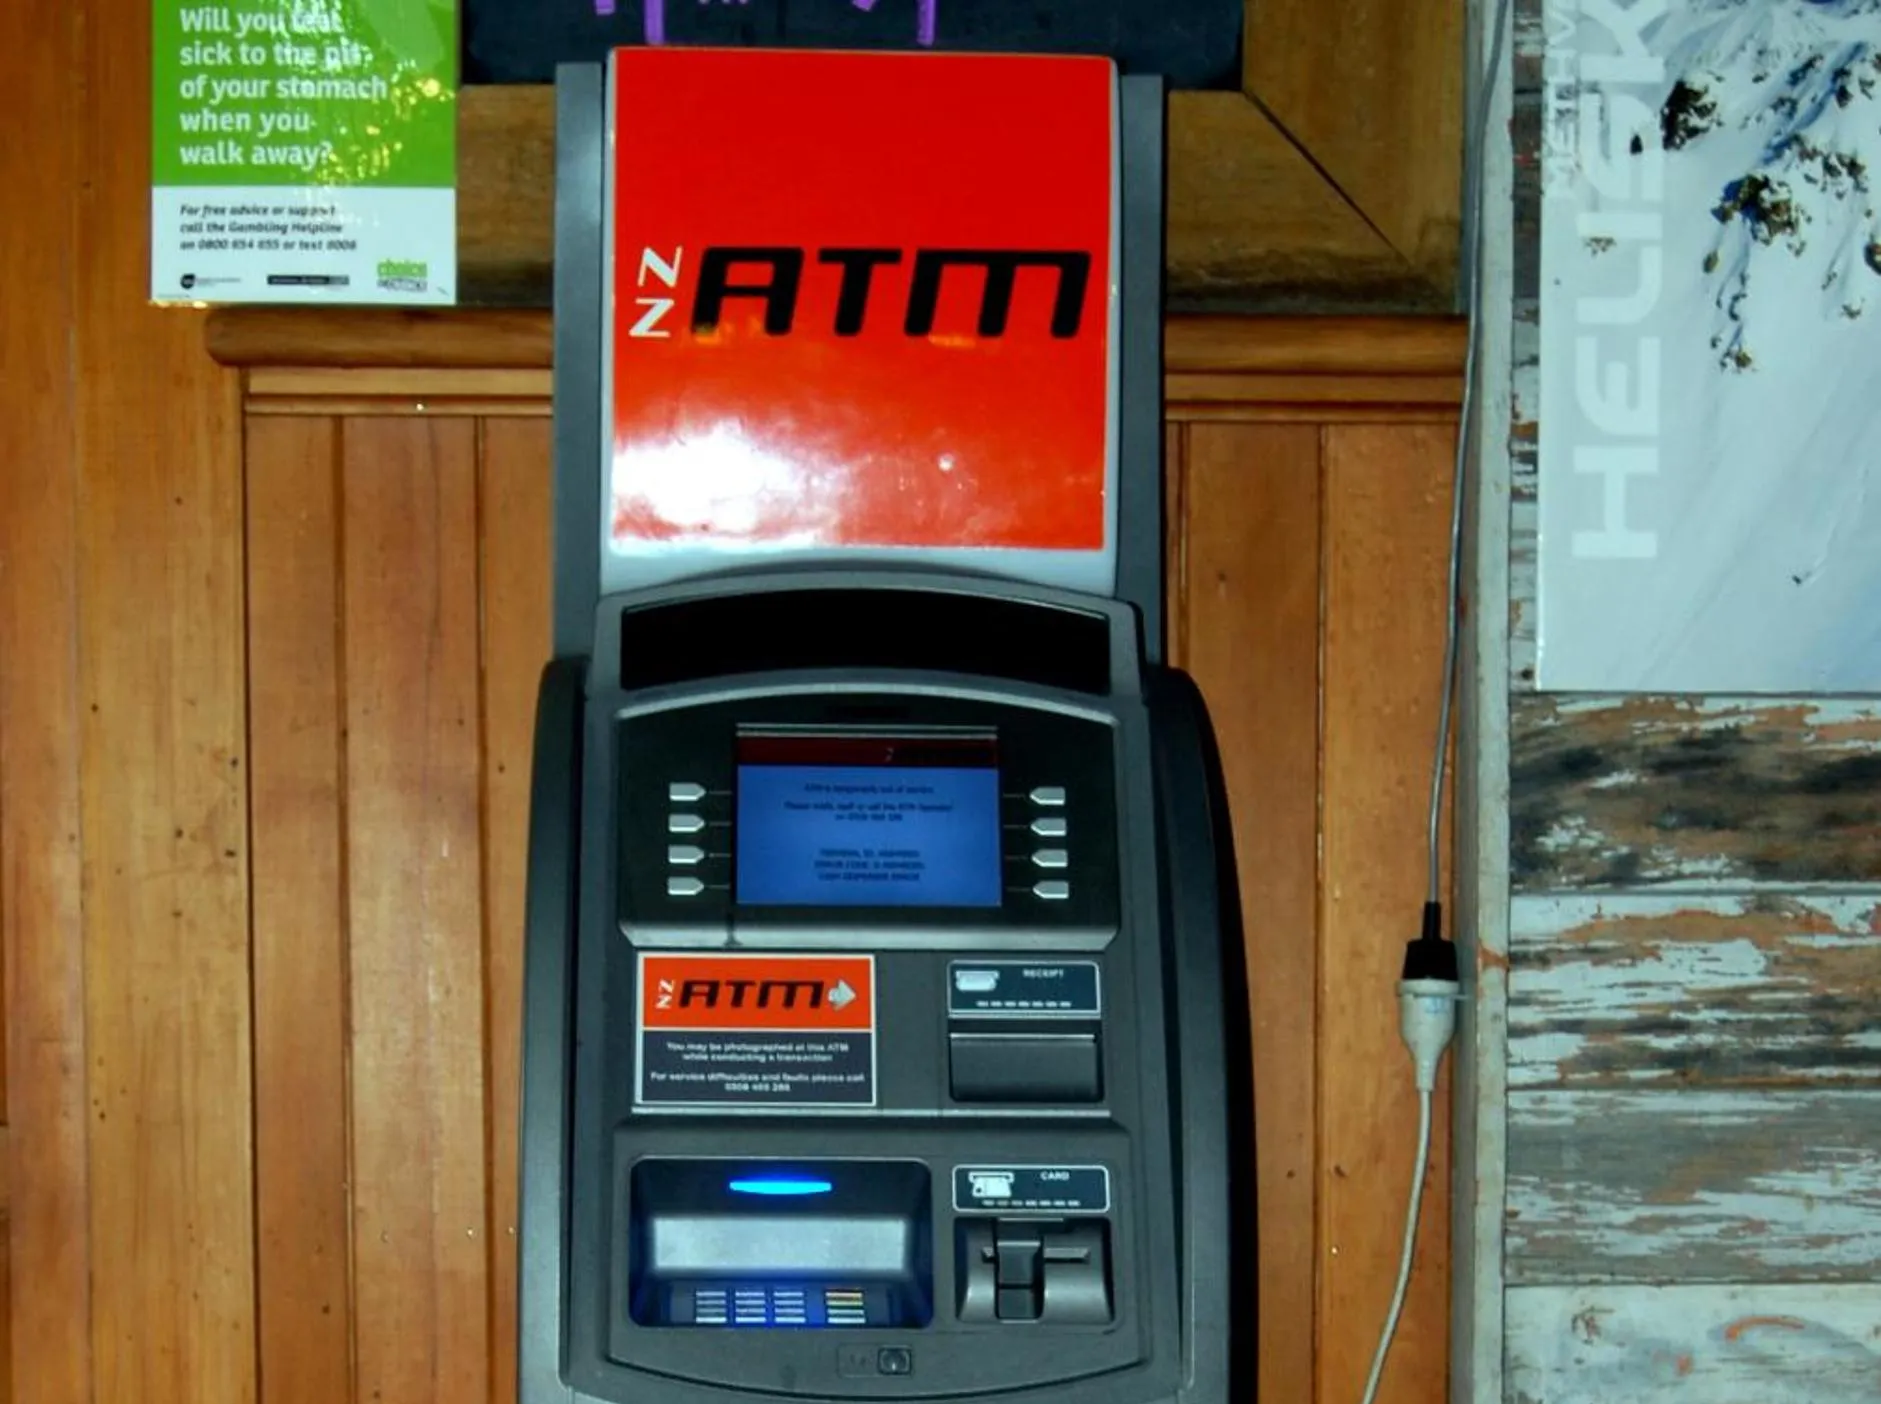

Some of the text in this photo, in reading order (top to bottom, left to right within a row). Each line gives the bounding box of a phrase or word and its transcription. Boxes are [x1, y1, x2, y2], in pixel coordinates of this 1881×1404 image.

[180, 7, 231, 33] Will
[235, 12, 285, 38] you
[180, 39, 232, 65] sick
[240, 42, 266, 65] to
[273, 39, 317, 66] the
[180, 75, 387, 105] of your stomach
[180, 108, 309, 138] when you
[180, 139, 333, 172] walk away?
[181, 205, 199, 216] For
[202, 205, 226, 217] free
[230, 205, 269, 216] advice
[272, 207, 285, 216] or
[180, 223, 203, 234] call
[207, 223, 225, 234] the
[228, 223, 289, 235] Gambling
[180, 241, 195, 250] on
[283, 241, 296, 250] or
[299, 240, 323, 250] text
[690, 246, 1092, 338] ATM
[1023, 968, 1064, 978] RECEIPT
[678, 980, 824, 1009] ATM
[667, 1042, 849, 1053] You may be photographed at this ATM
[683, 1053, 708, 1061] while
[710, 1053, 766, 1063] conducting
[777, 1053, 832, 1062] transaction
[651, 1072, 666, 1081] For
[669, 1073, 705, 1081] service
[707, 1072, 759, 1082] difficulties
[762, 1073, 780, 1082] and
[812, 1073, 845, 1083] please
[847, 1073, 865, 1082] call
[1039, 1171, 1070, 1181] CARD
